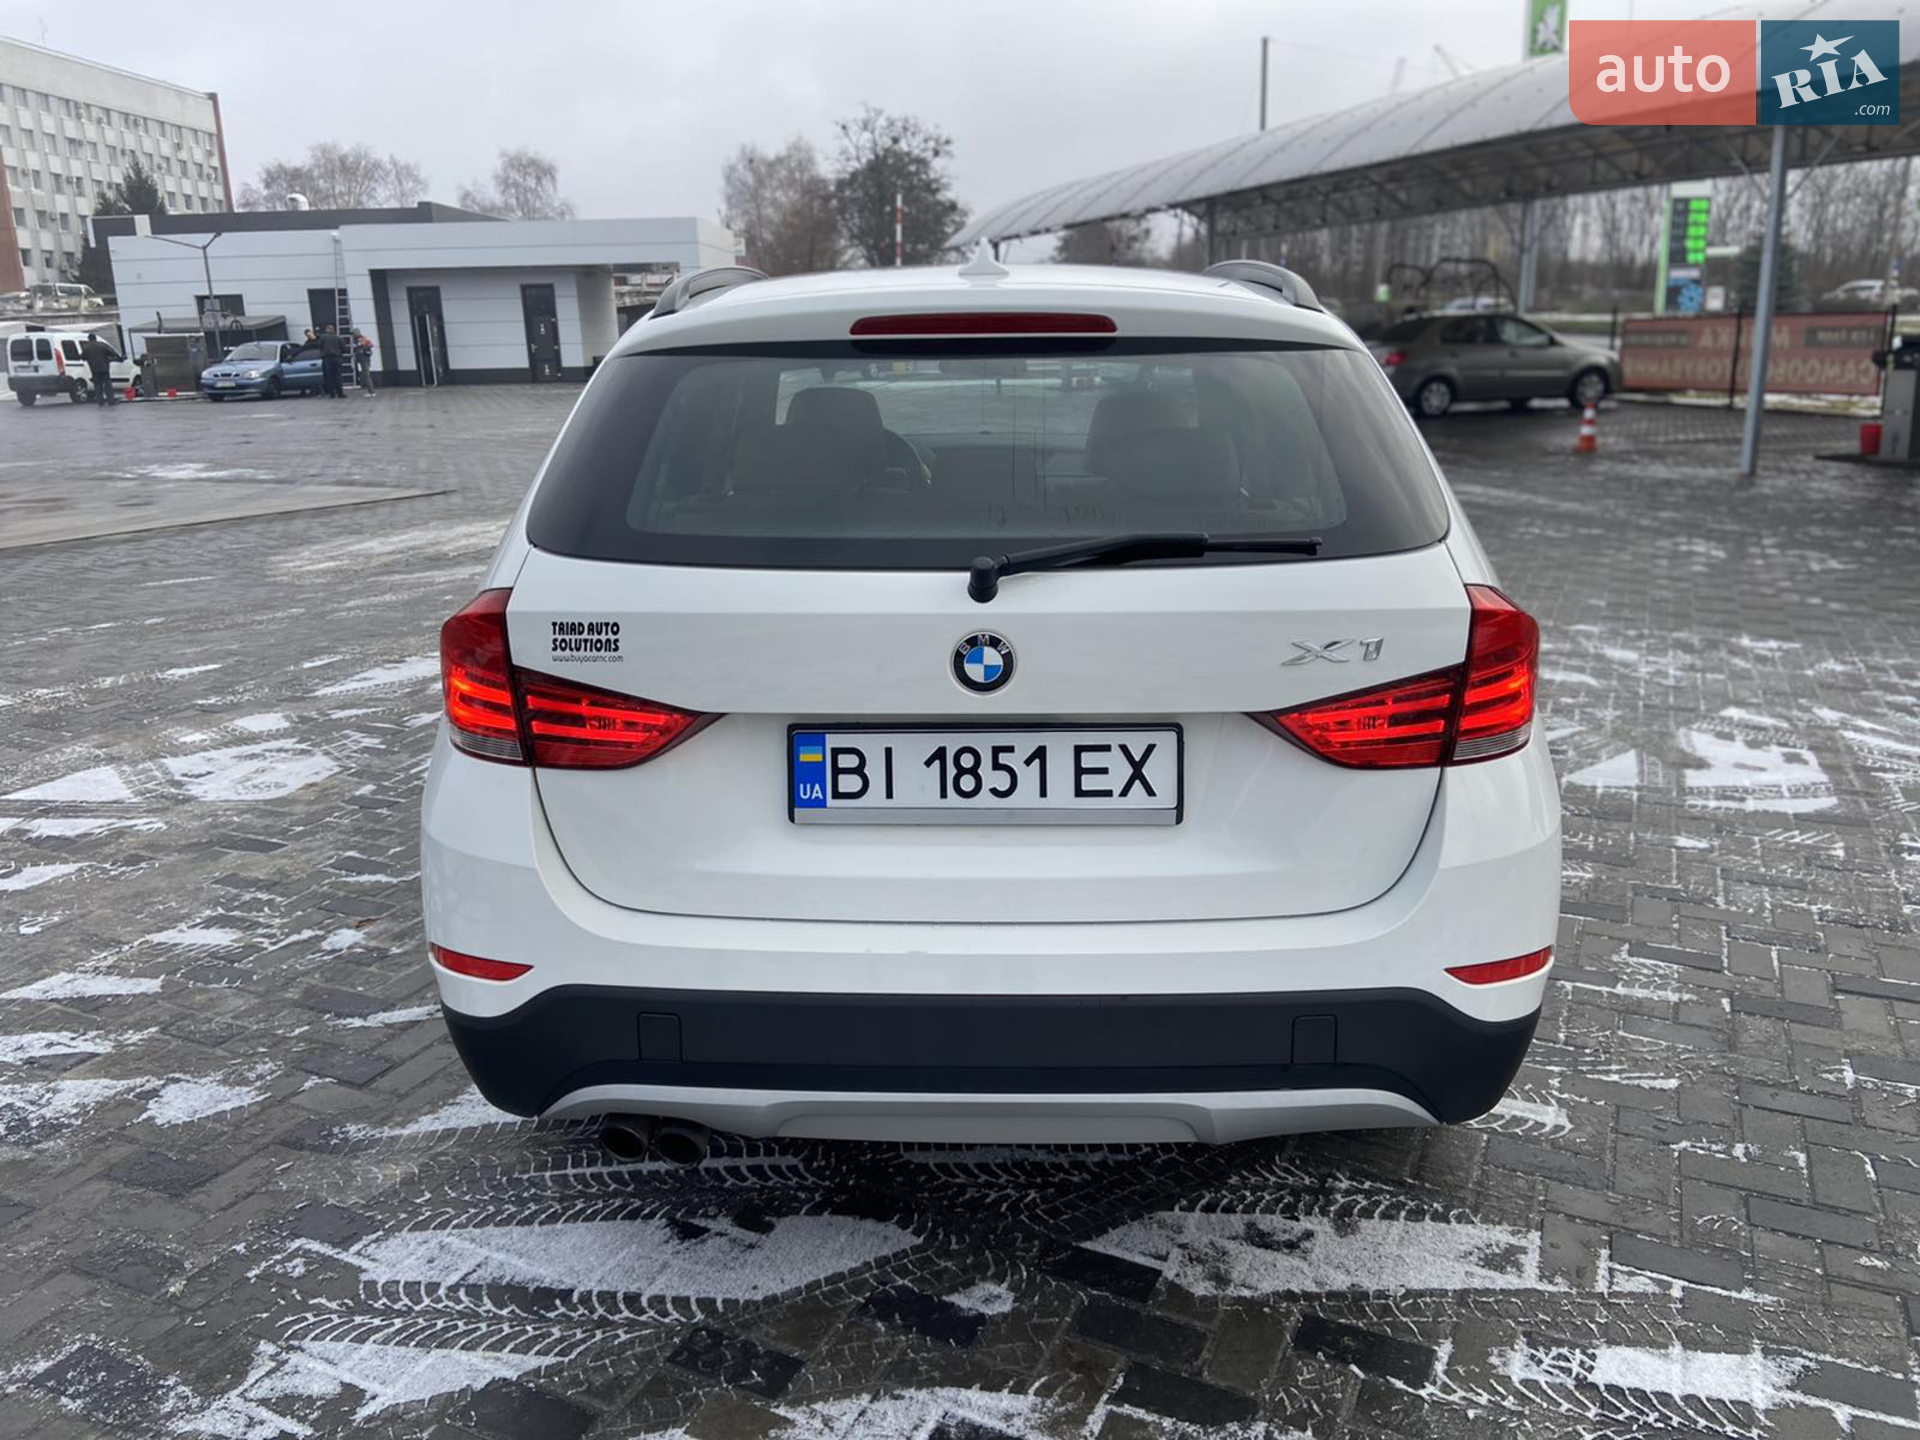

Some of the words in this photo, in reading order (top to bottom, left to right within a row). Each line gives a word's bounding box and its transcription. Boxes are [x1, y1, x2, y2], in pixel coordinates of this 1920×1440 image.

[551, 621, 585, 636] TRIAD
[587, 621, 620, 636] AUTO
[551, 637, 620, 652] SOLUTIONS
[1281, 636, 1386, 666] X1
[830, 746, 893, 799] BI
[923, 744, 1048, 799] 1851
[1073, 743, 1158, 798] EX
[799, 783, 823, 800] UA
